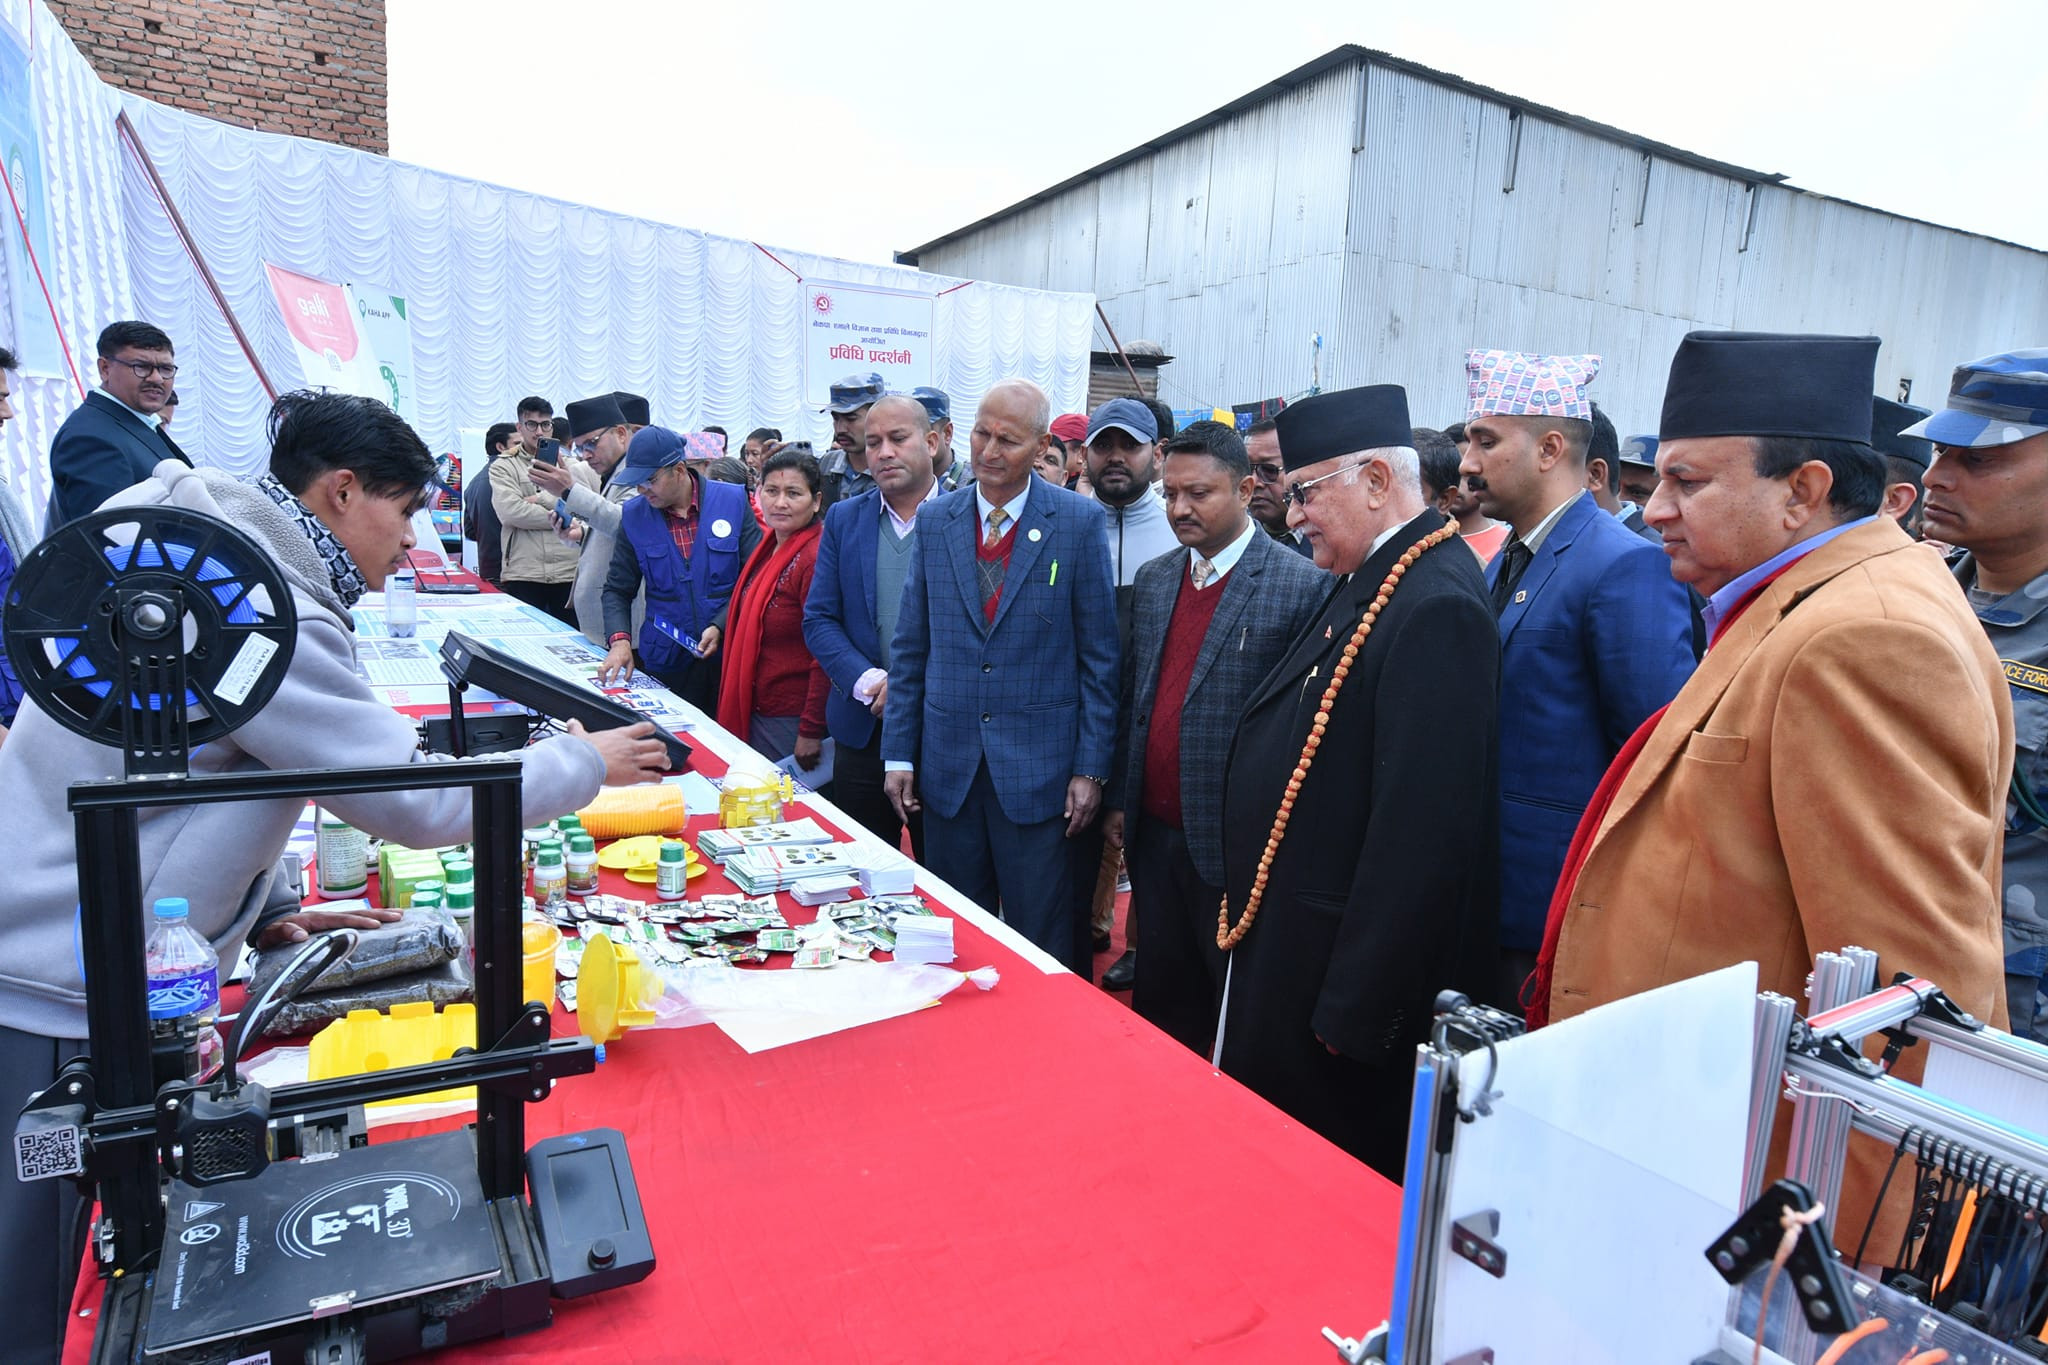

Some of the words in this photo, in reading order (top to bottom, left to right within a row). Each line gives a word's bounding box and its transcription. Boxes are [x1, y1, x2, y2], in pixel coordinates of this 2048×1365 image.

[296, 292, 330, 318] galli
[829, 344, 864, 361] प्रविधि
[868, 349, 912, 365] प्रदर्शनी
[386, 1217, 411, 1238] 3D
[234, 1215, 250, 1275] www.wol3d.com
